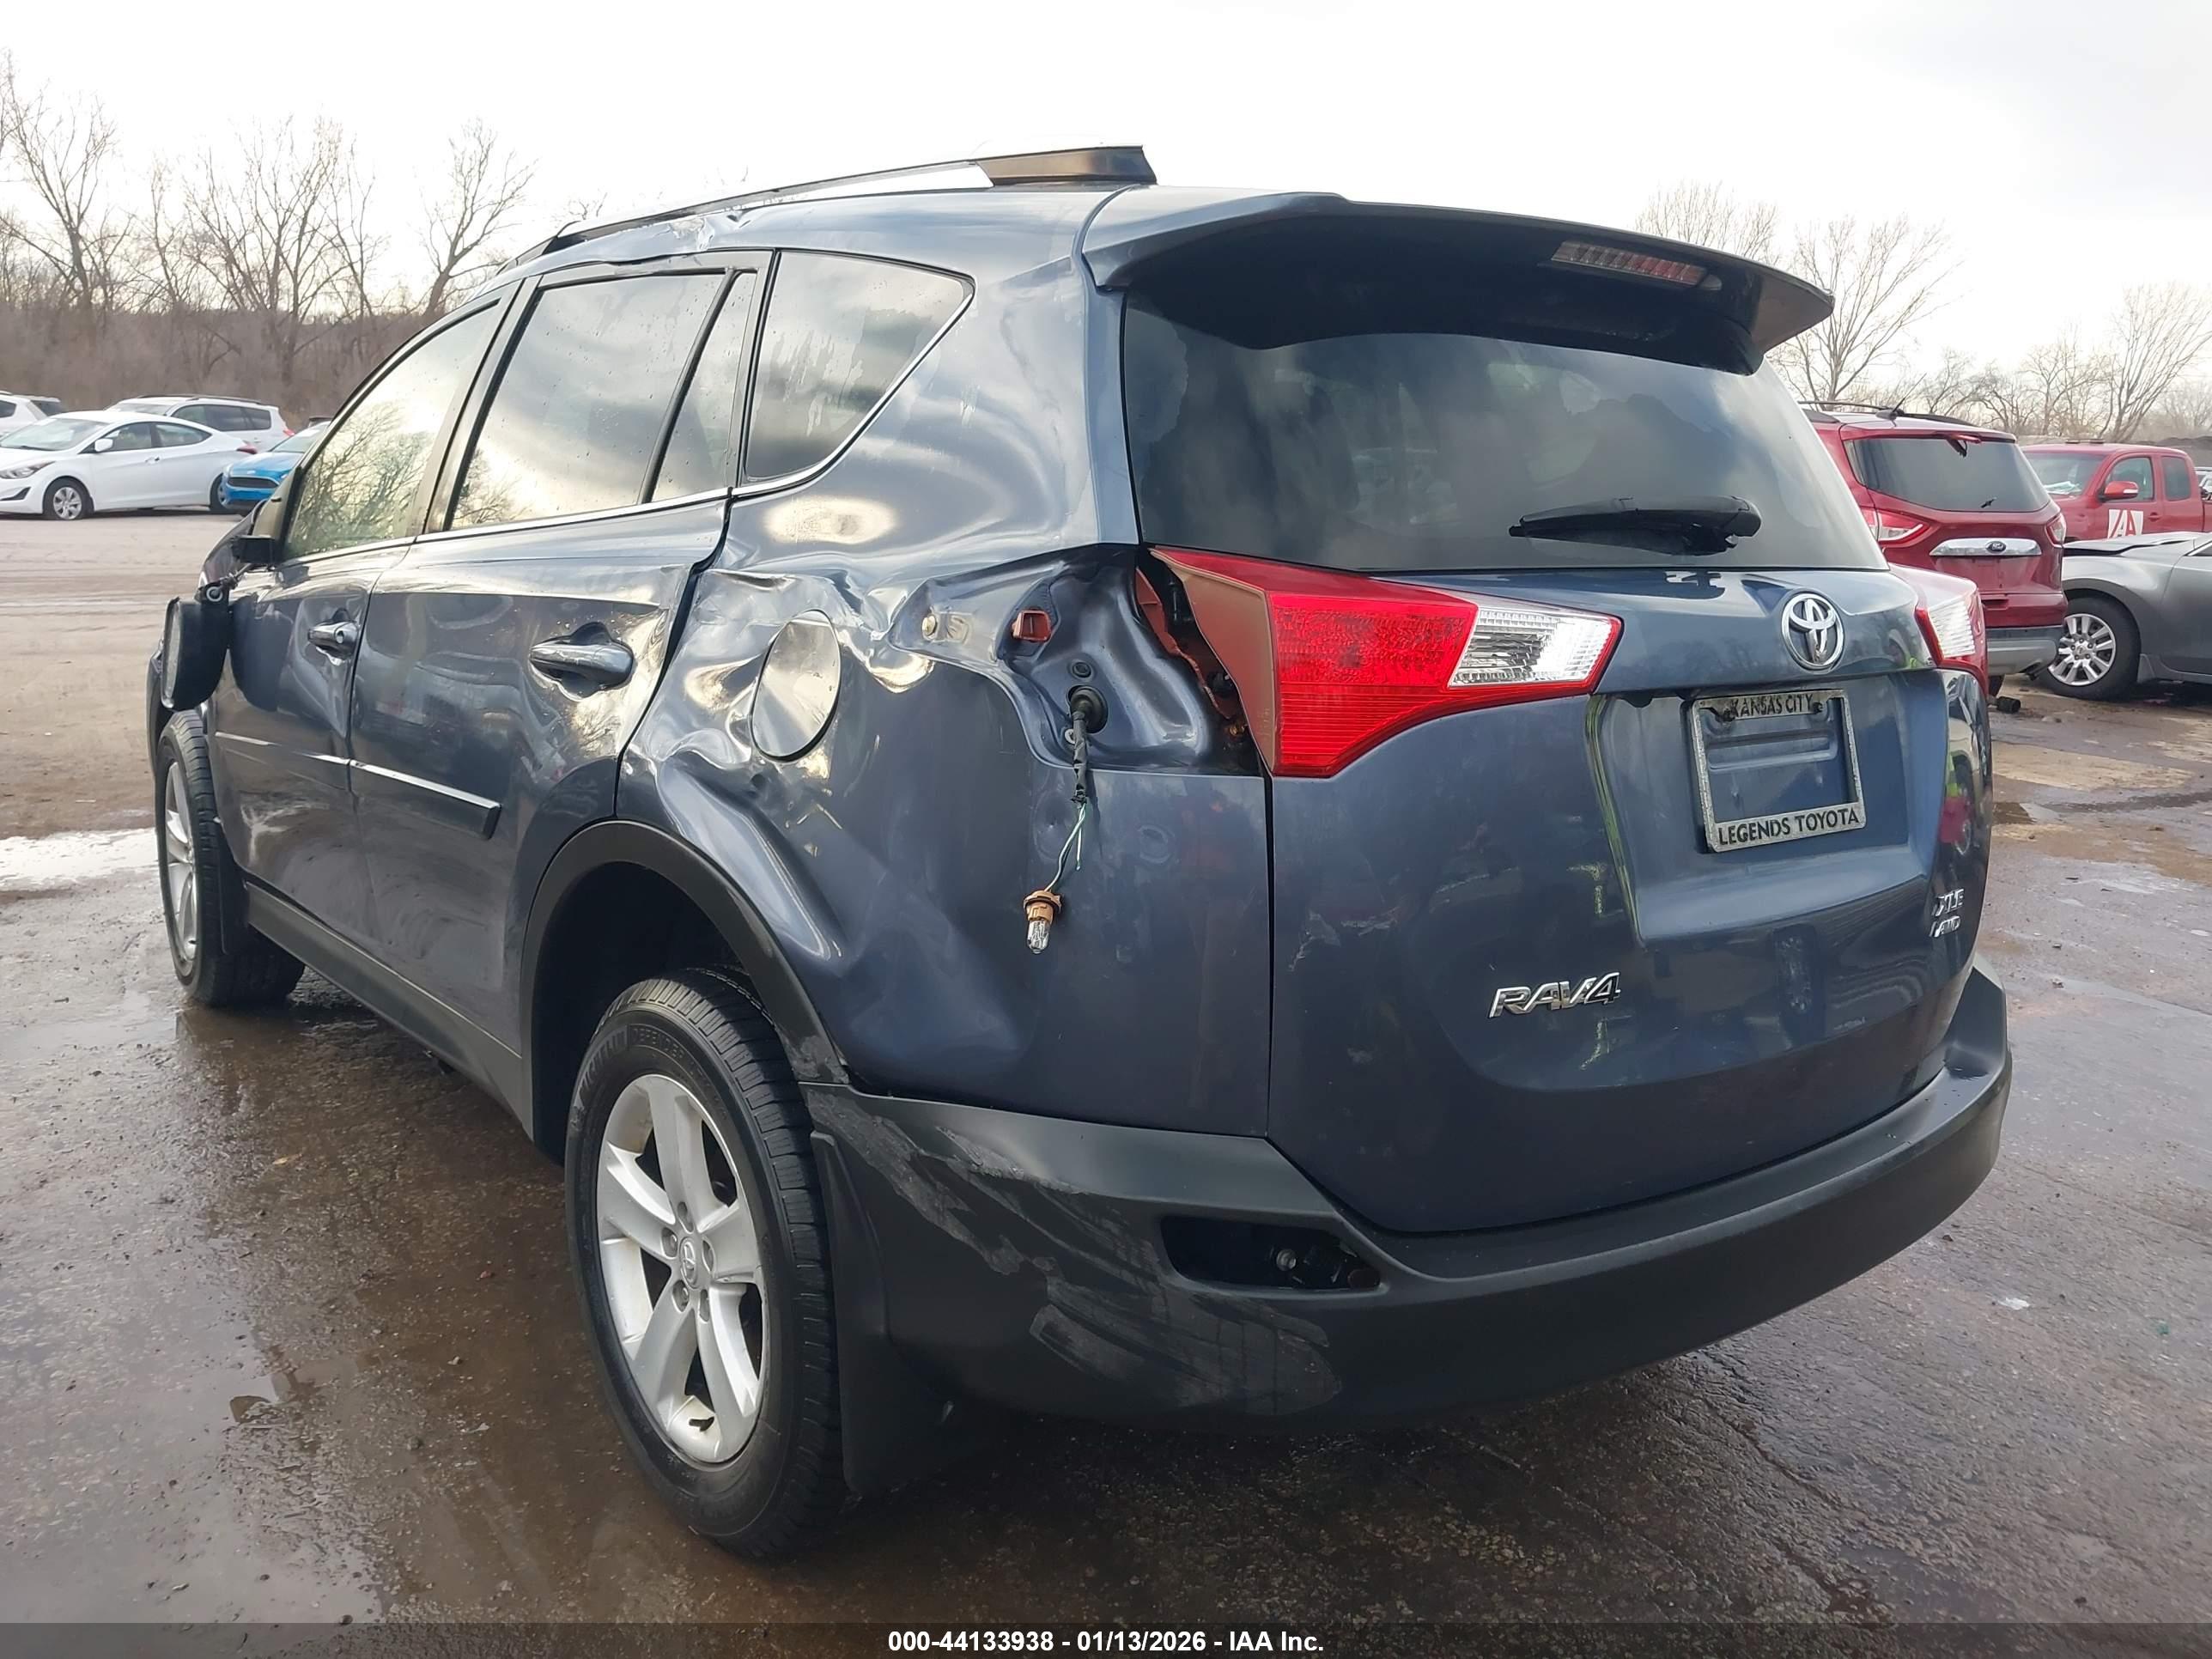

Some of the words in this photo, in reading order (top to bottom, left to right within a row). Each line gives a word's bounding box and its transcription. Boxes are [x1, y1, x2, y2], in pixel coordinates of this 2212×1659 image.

[1729, 696, 1783, 719] KANSAS
[1785, 693, 1814, 714] CITY
[1718, 817, 1791, 846] LEGENDS
[1794, 807, 1861, 833] TOYOTA
[1488, 971, 1621, 1018] RAV4
